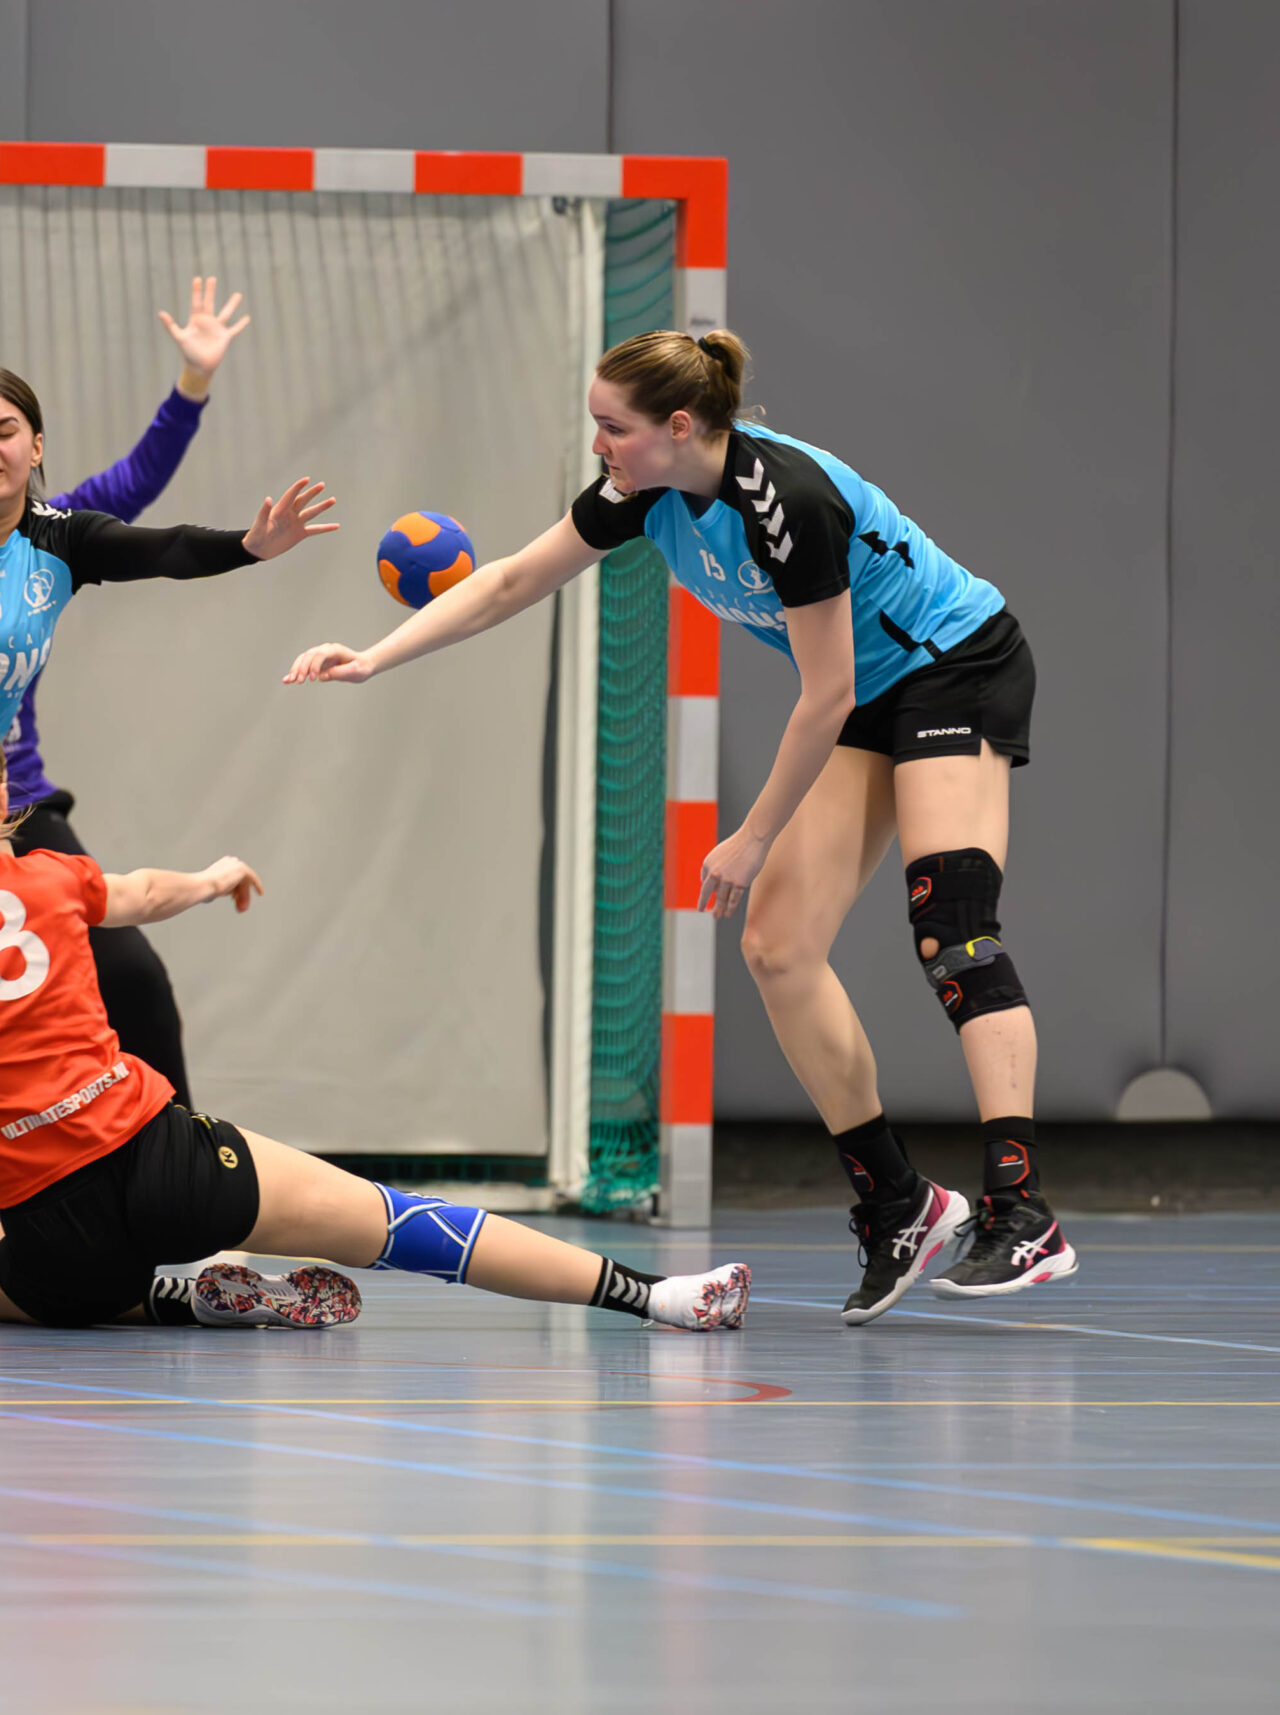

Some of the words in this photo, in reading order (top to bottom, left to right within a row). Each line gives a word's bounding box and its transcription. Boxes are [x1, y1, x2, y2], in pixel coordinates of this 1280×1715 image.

[699, 549, 726, 581] 15
[917, 727, 972, 738] STANNO
[0, 1061, 130, 1140] ULTIMATESPORTS.NL
